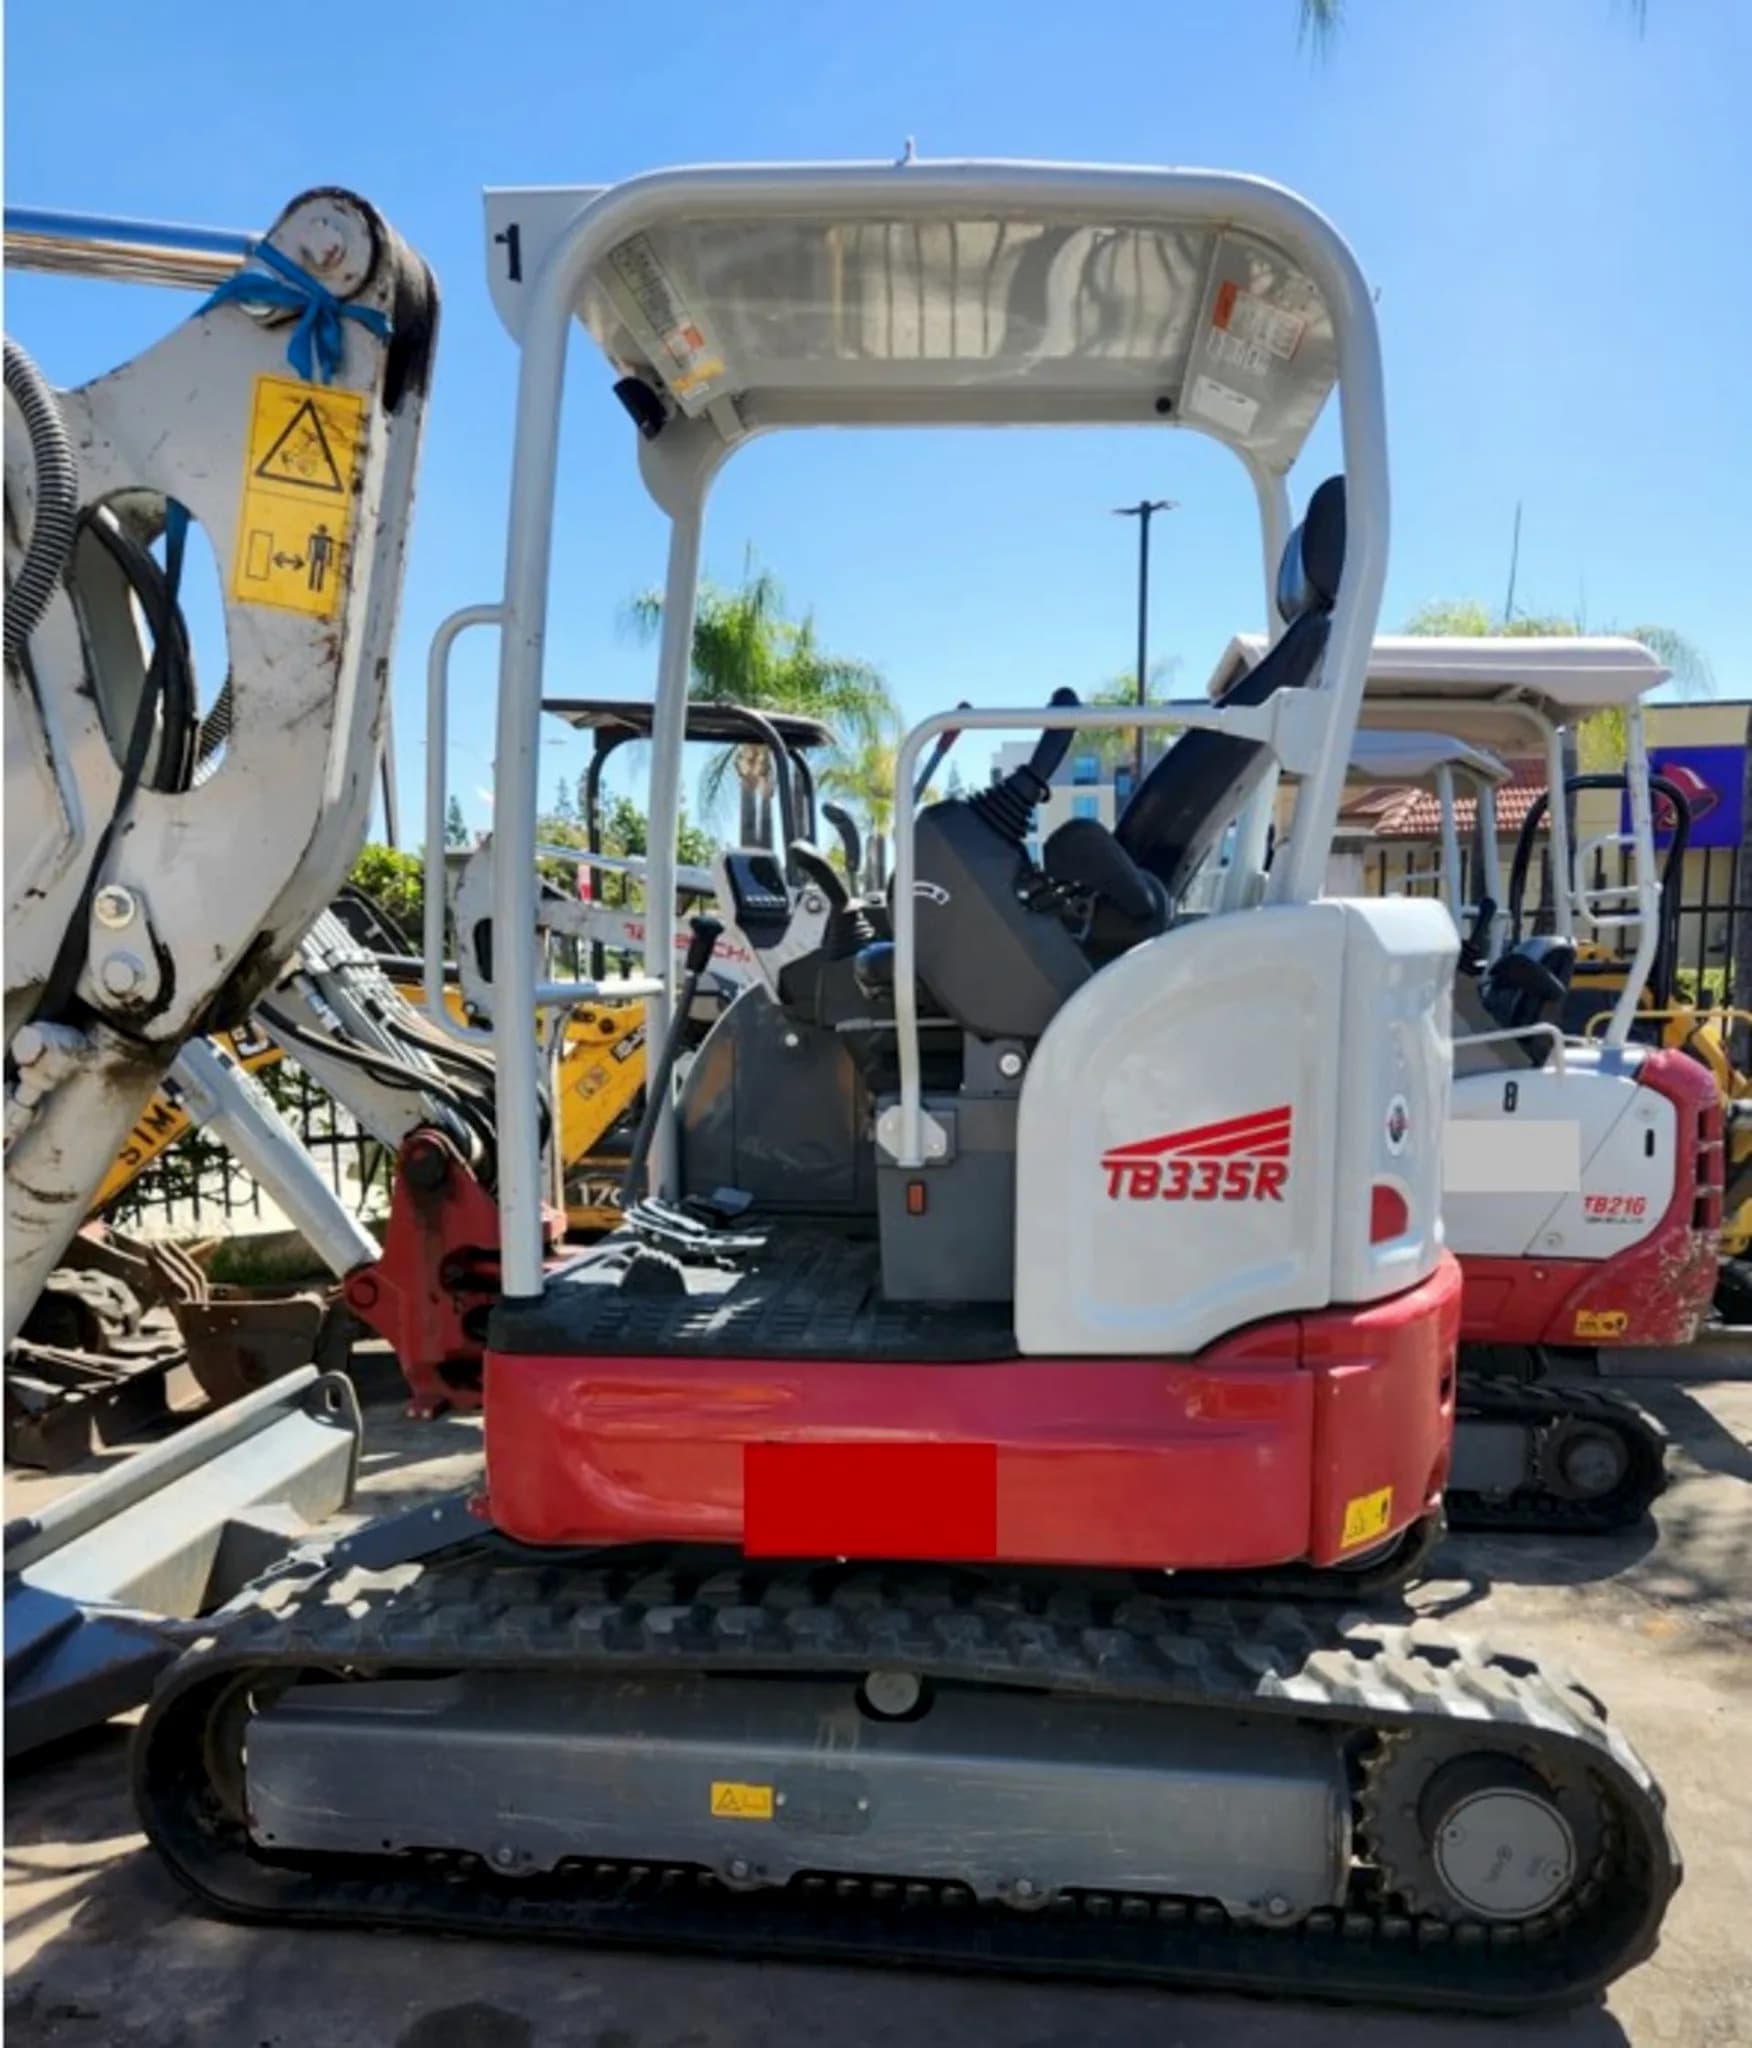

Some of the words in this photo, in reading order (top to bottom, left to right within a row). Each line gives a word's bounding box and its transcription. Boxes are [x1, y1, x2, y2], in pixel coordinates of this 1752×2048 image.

[494, 223, 522, 283] 1
[1503, 1079, 1518, 1113] 8
[1101, 1160, 1288, 1201] TB335R
[1584, 1195, 1647, 1216] TB216
